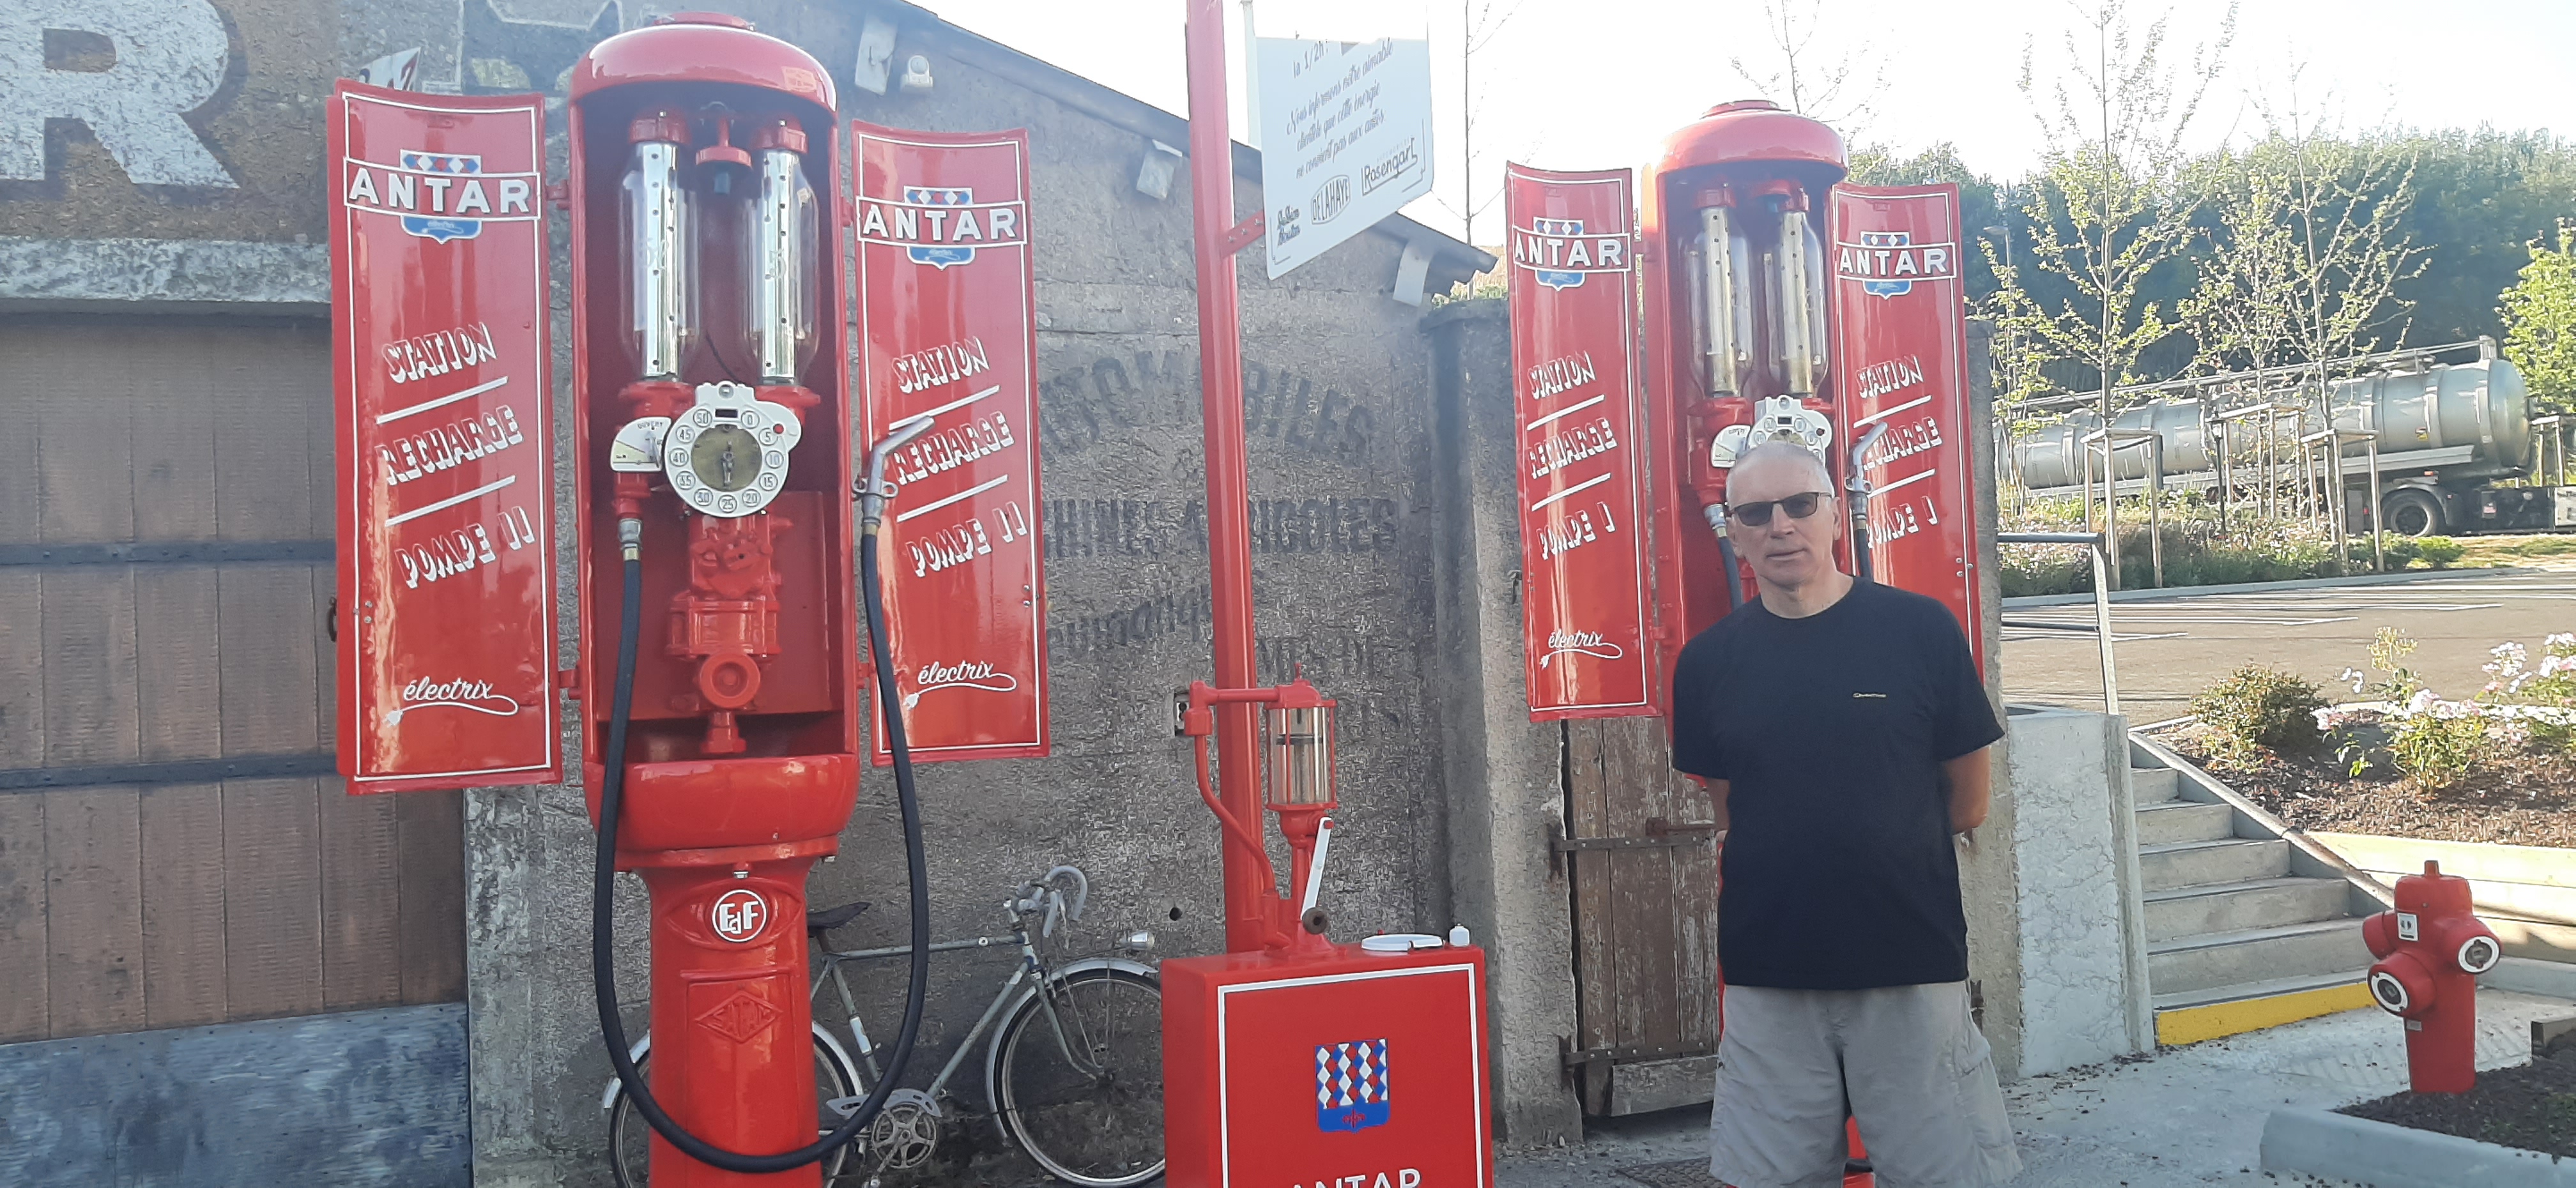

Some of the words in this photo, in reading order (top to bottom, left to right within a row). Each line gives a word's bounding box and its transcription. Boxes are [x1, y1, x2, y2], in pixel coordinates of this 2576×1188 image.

[1362, 37, 1393, 77] aimable
[1363, 137, 1417, 190] Rosengart
[349, 167, 530, 214] ANTAR
[1313, 178, 1349, 221] DELAHAYE
[862, 204, 1016, 241] ANTAR
[1515, 232, 1622, 267] ANTAR
[1839, 247, 1948, 275] ANTAR
[381, 321, 497, 383] STATION
[892, 335, 990, 394] STATION
[1528, 350, 1596, 400] STATION
[1855, 353, 1924, 399] STATION
[374, 405, 523, 485] RECHARGE
[679, 429, 691, 439] 45
[890, 411, 1015, 485] RECHARGE
[1527, 417, 1617, 479] RECHARGE
[673, 452, 686, 463] 40
[770, 455, 781, 465] 10
[746, 493, 758, 504] 20
[763, 477, 774, 487] 15
[722, 499, 734, 510] 25
[906, 518, 992, 577] POMPE
[1537, 510, 1597, 560] POMPE
[394, 523, 496, 589] POMPE
[1548, 628, 1604, 649] électrix
[403, 676, 494, 701] électrix
[917, 660, 994, 685] électrix
[719, 901, 759, 934] EdF
